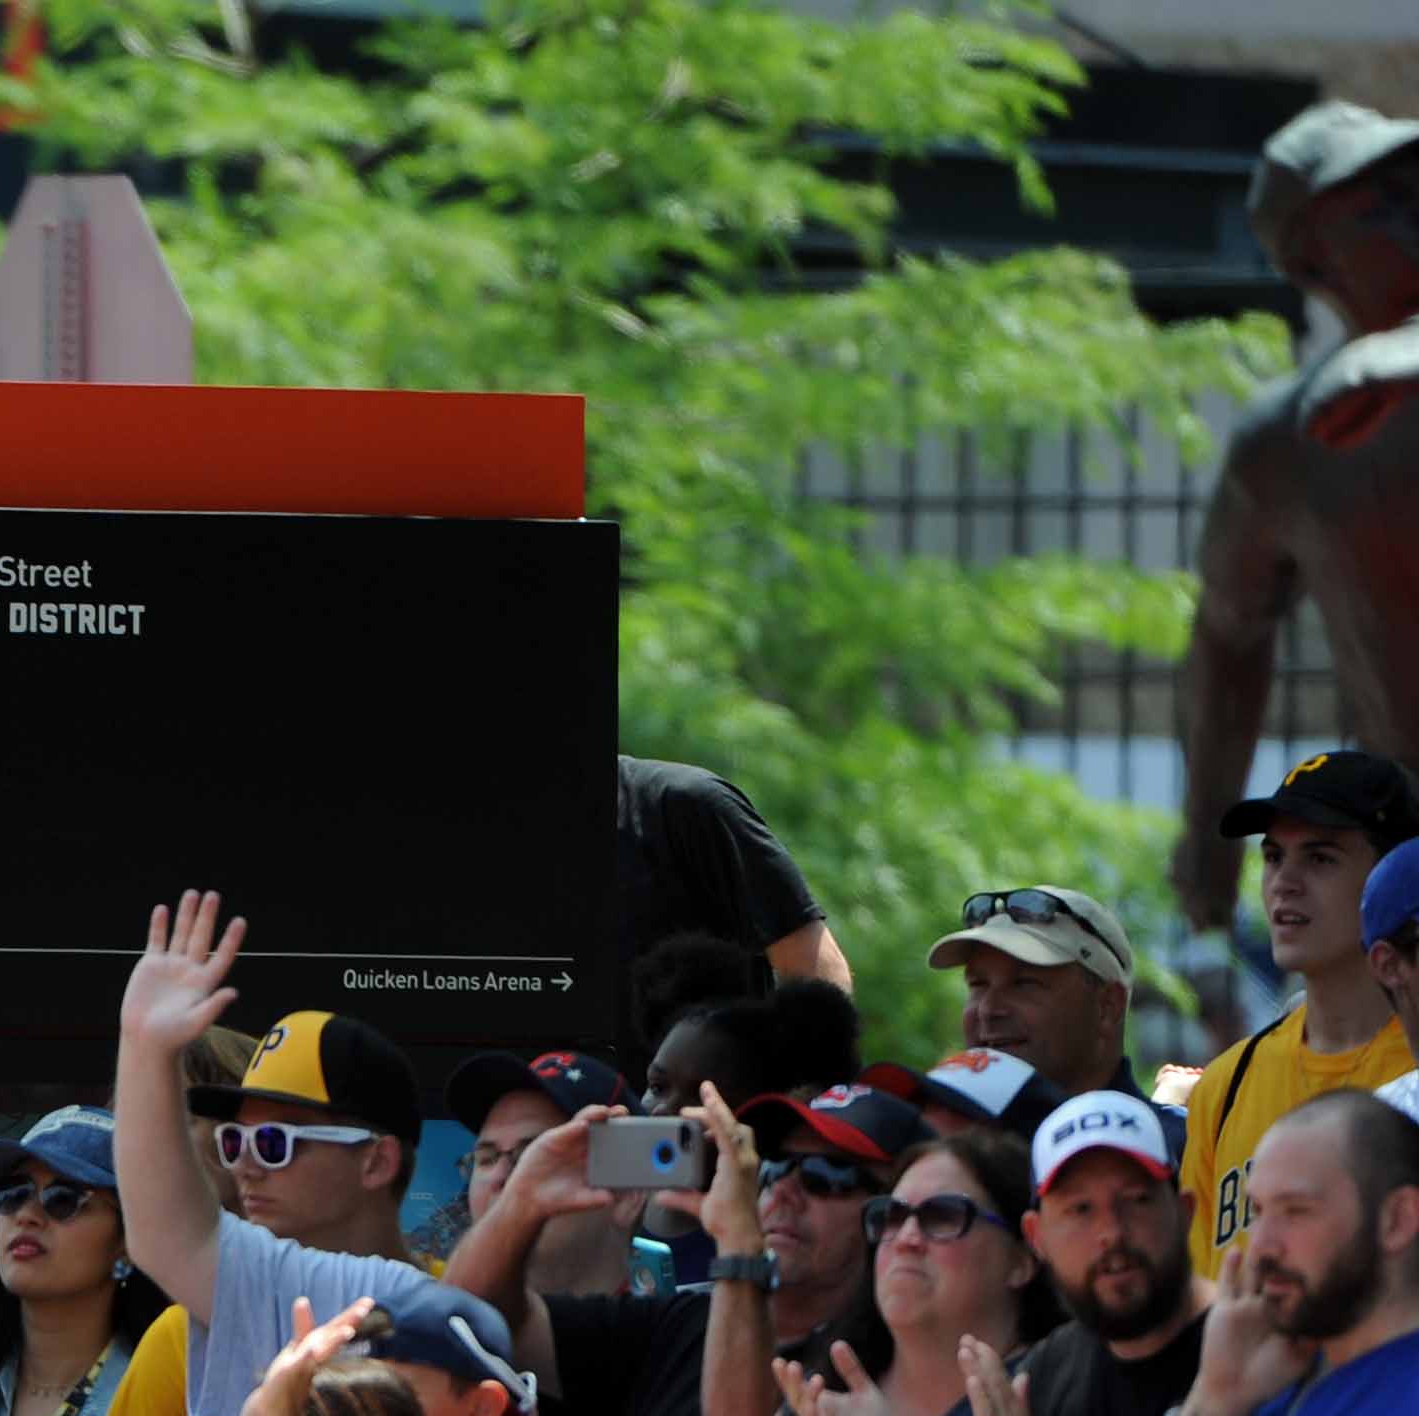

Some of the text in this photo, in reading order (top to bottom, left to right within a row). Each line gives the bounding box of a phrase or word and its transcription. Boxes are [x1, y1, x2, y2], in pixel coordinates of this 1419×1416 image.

[9, 603, 146, 635] DISTRICT
[343, 969, 542, 991] Quicken Loans Arena
[252, 1026, 290, 1070] P
[1052, 1111, 1142, 1145] SOX
